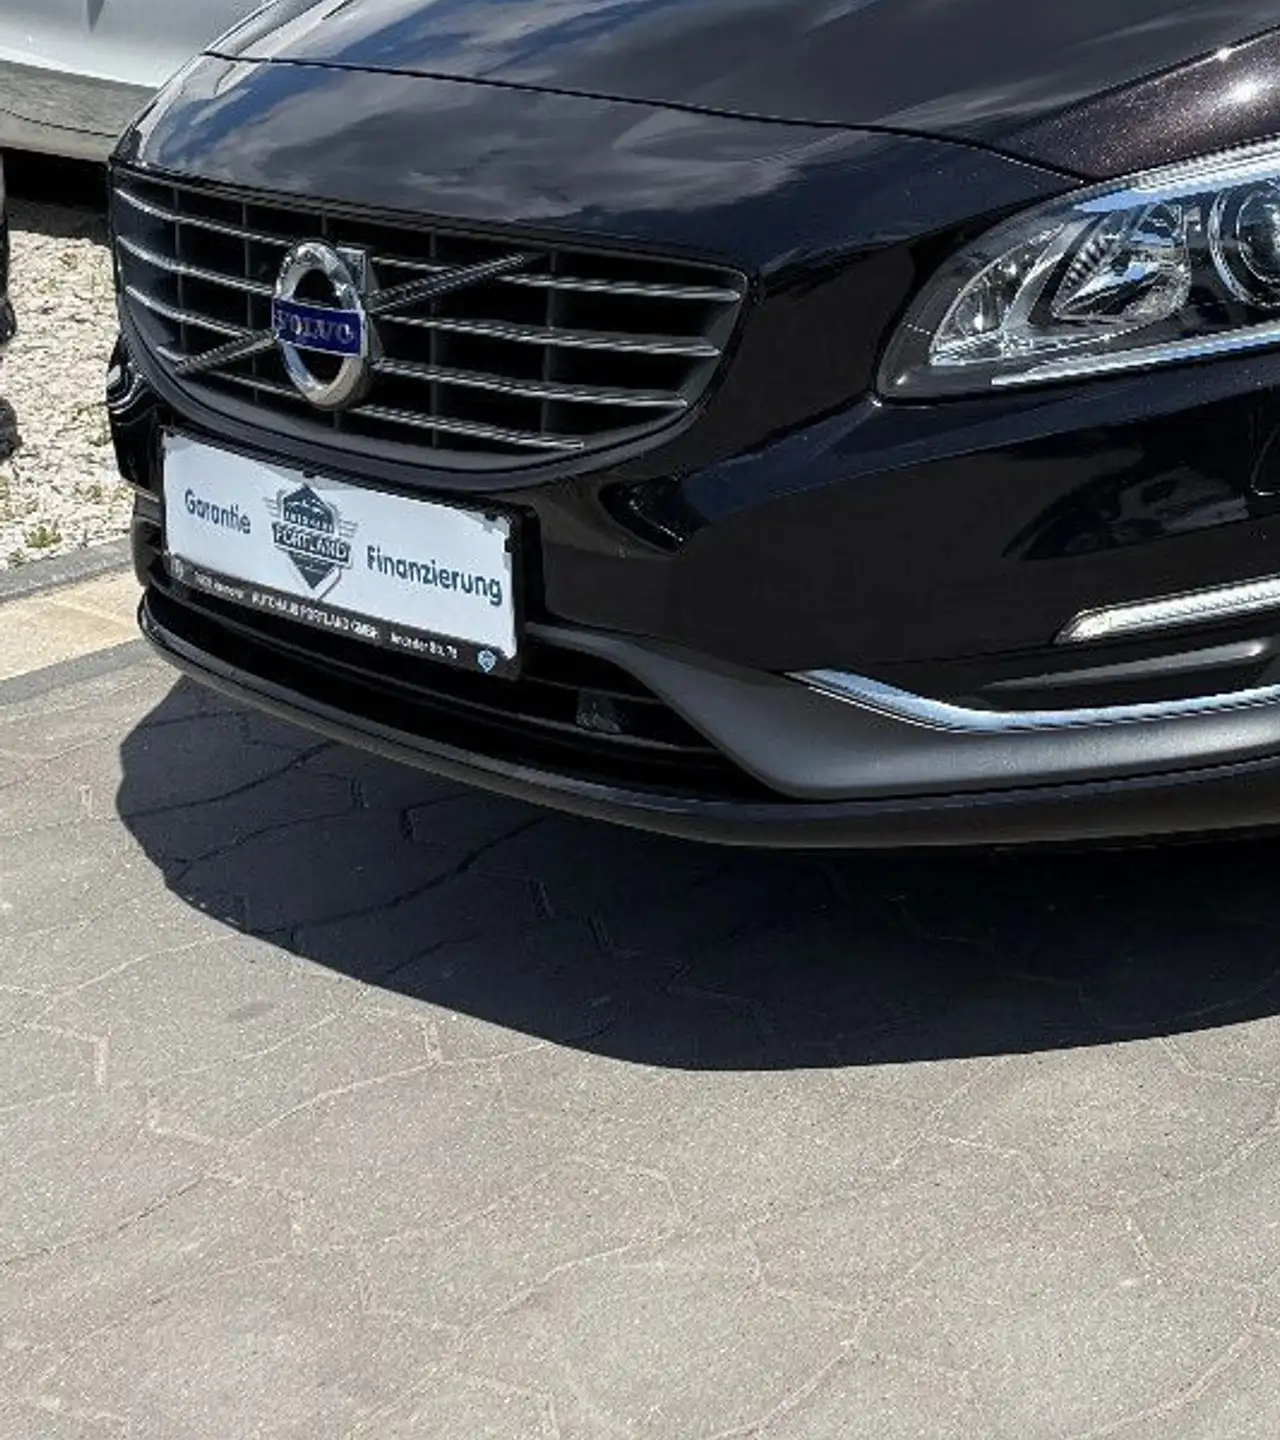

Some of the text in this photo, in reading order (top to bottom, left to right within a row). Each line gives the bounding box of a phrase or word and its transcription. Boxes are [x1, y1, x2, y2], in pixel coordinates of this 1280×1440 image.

[277, 309, 355, 345] VOLVO
[185, 488, 251, 535] Garantie
[367, 545, 502, 606] Finanzierung
